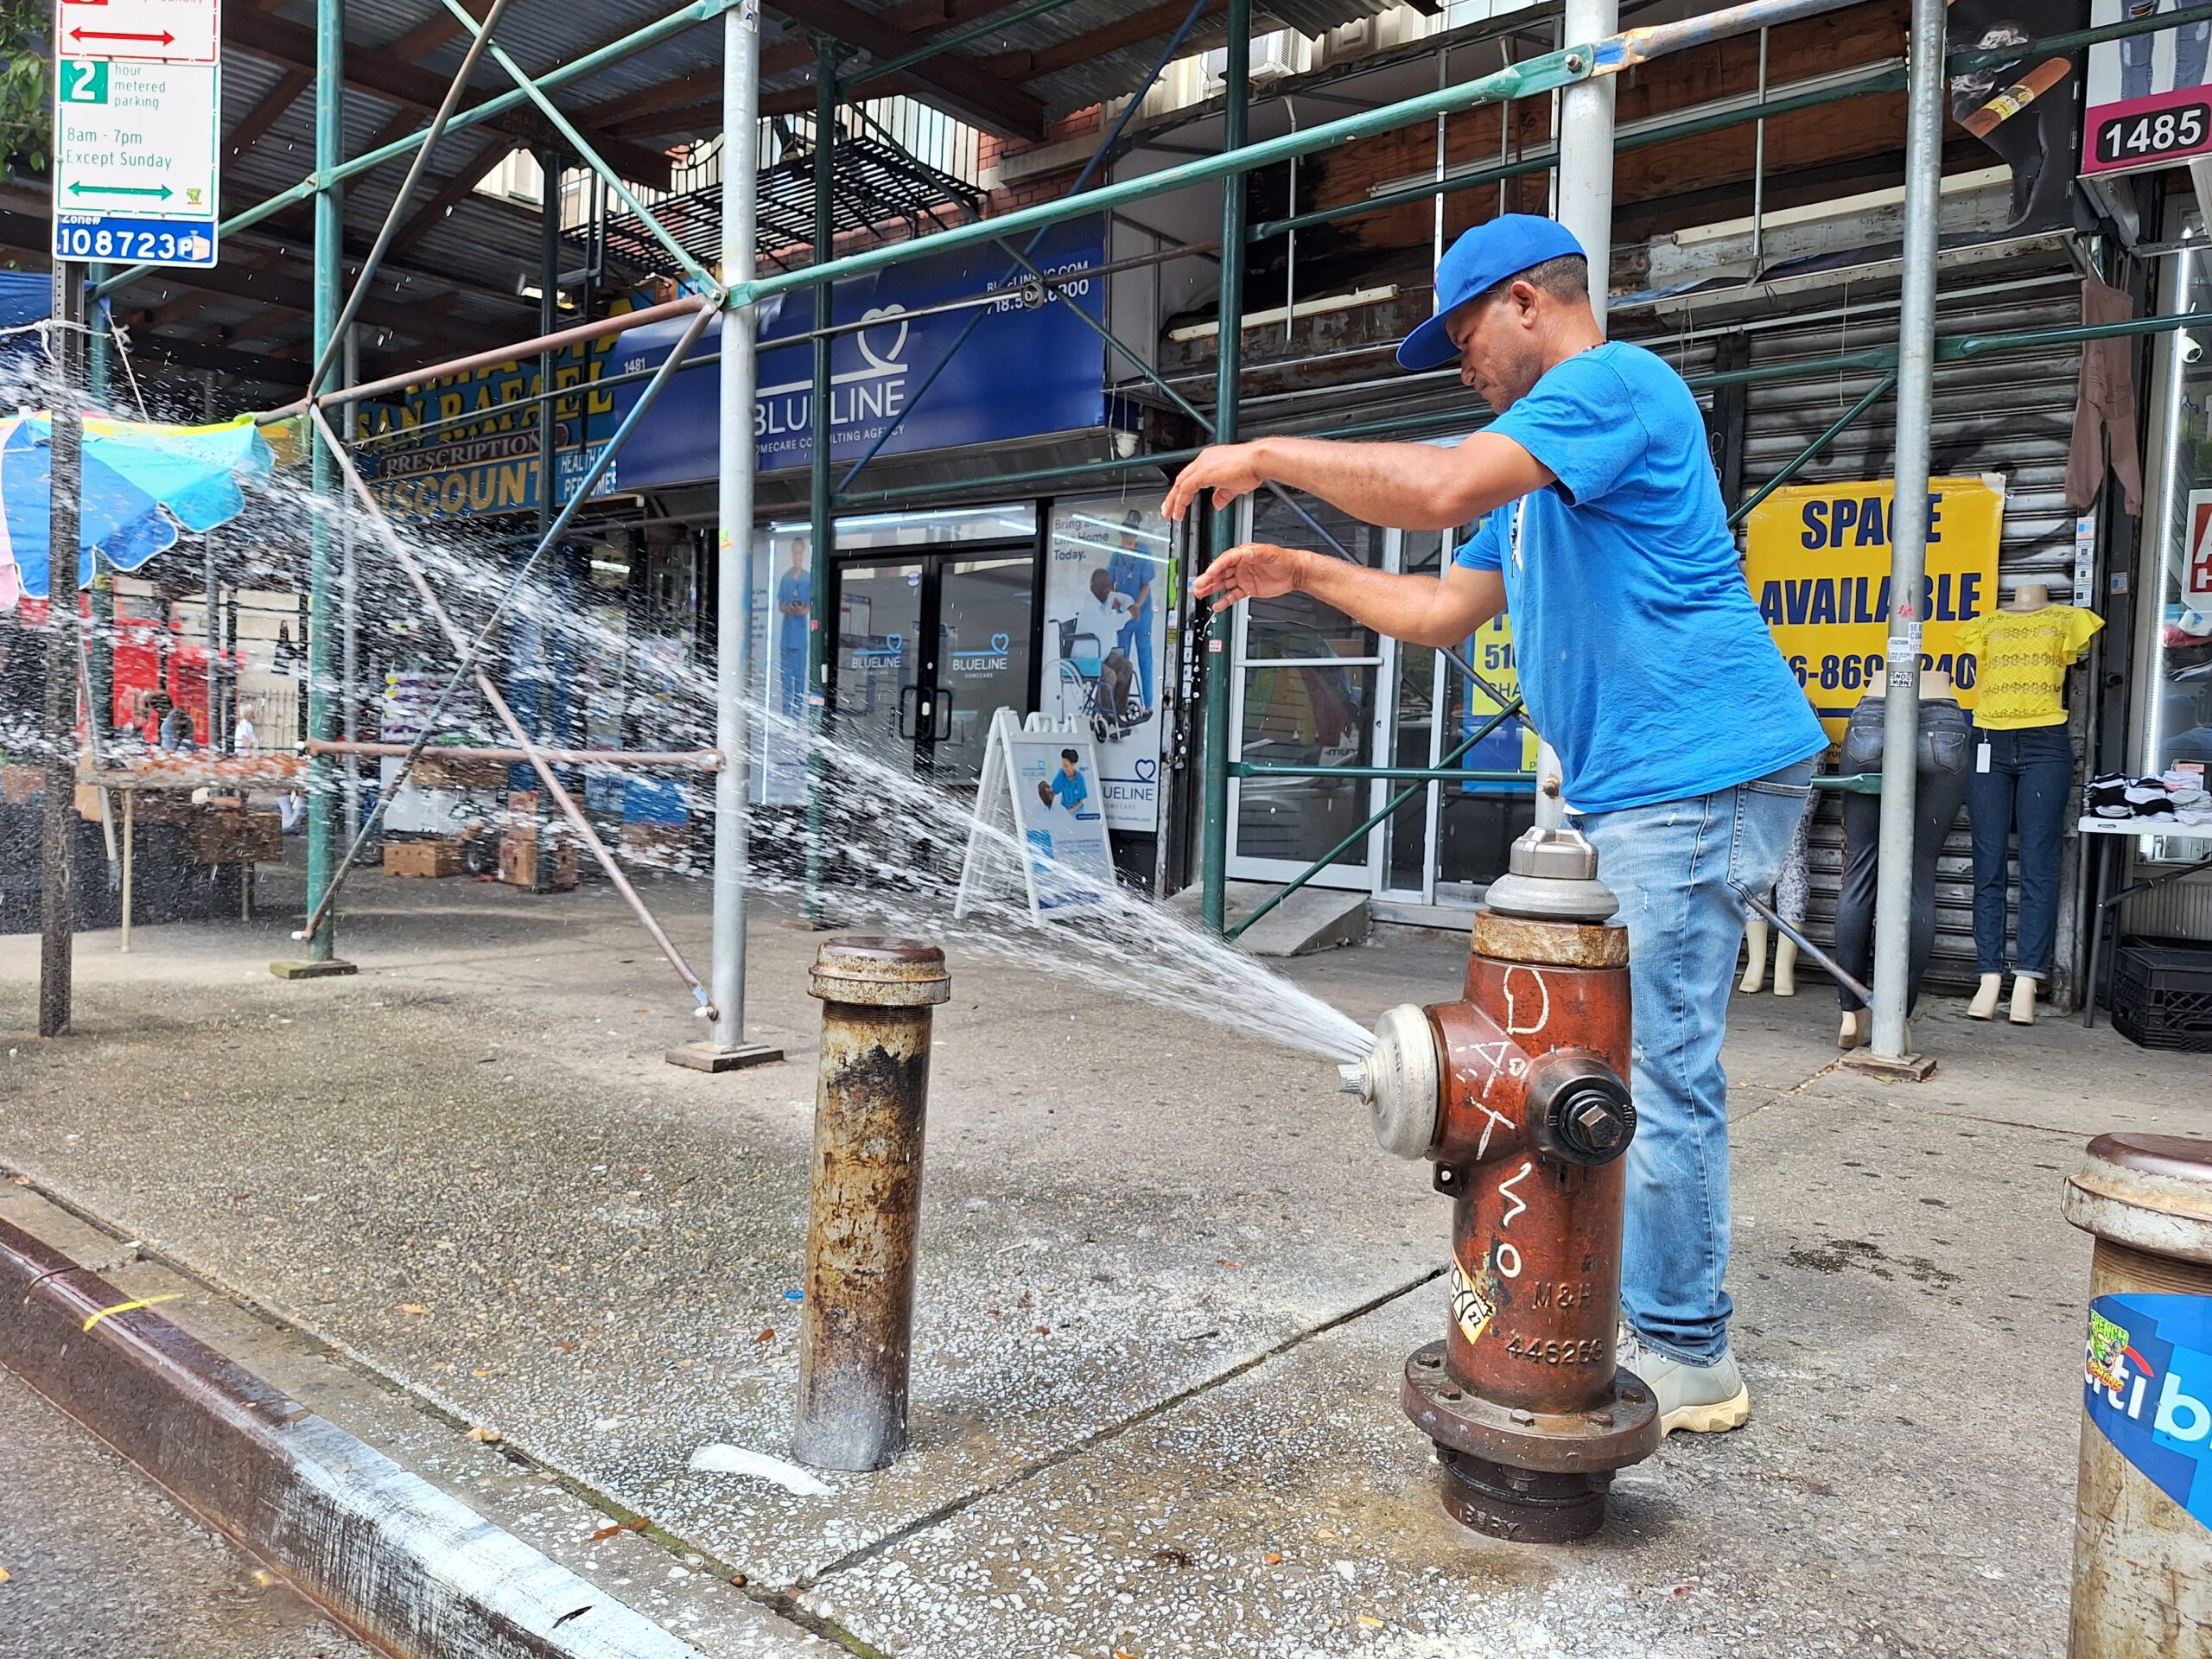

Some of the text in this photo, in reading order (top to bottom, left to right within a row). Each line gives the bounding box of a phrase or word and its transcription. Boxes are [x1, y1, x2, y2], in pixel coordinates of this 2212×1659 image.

[114, 64, 142, 76] hour
[71, 60, 96, 100] 2
[114, 79, 166, 92] metered
[114, 95, 159, 110] parking
[67, 127, 97, 143] 8am
[113, 129, 143, 145] 7pm
[2105, 108, 2202, 158] 1485
[66, 149, 173, 170] Except Sunday
[61, 216, 101, 226] Zone#
[61, 228, 175, 259] 108723
[623, 358, 646, 375] 1481
[754, 379, 906, 437] BLULINE
[561, 448, 598, 475] HEALTH
[1054, 518, 1082, 531] Bring
[1077, 532, 1109, 543] Home
[1053, 549, 1086, 562] Today.
[851, 657, 901, 669] BLUELINE
[952, 658, 1007, 671] BLUELINE
